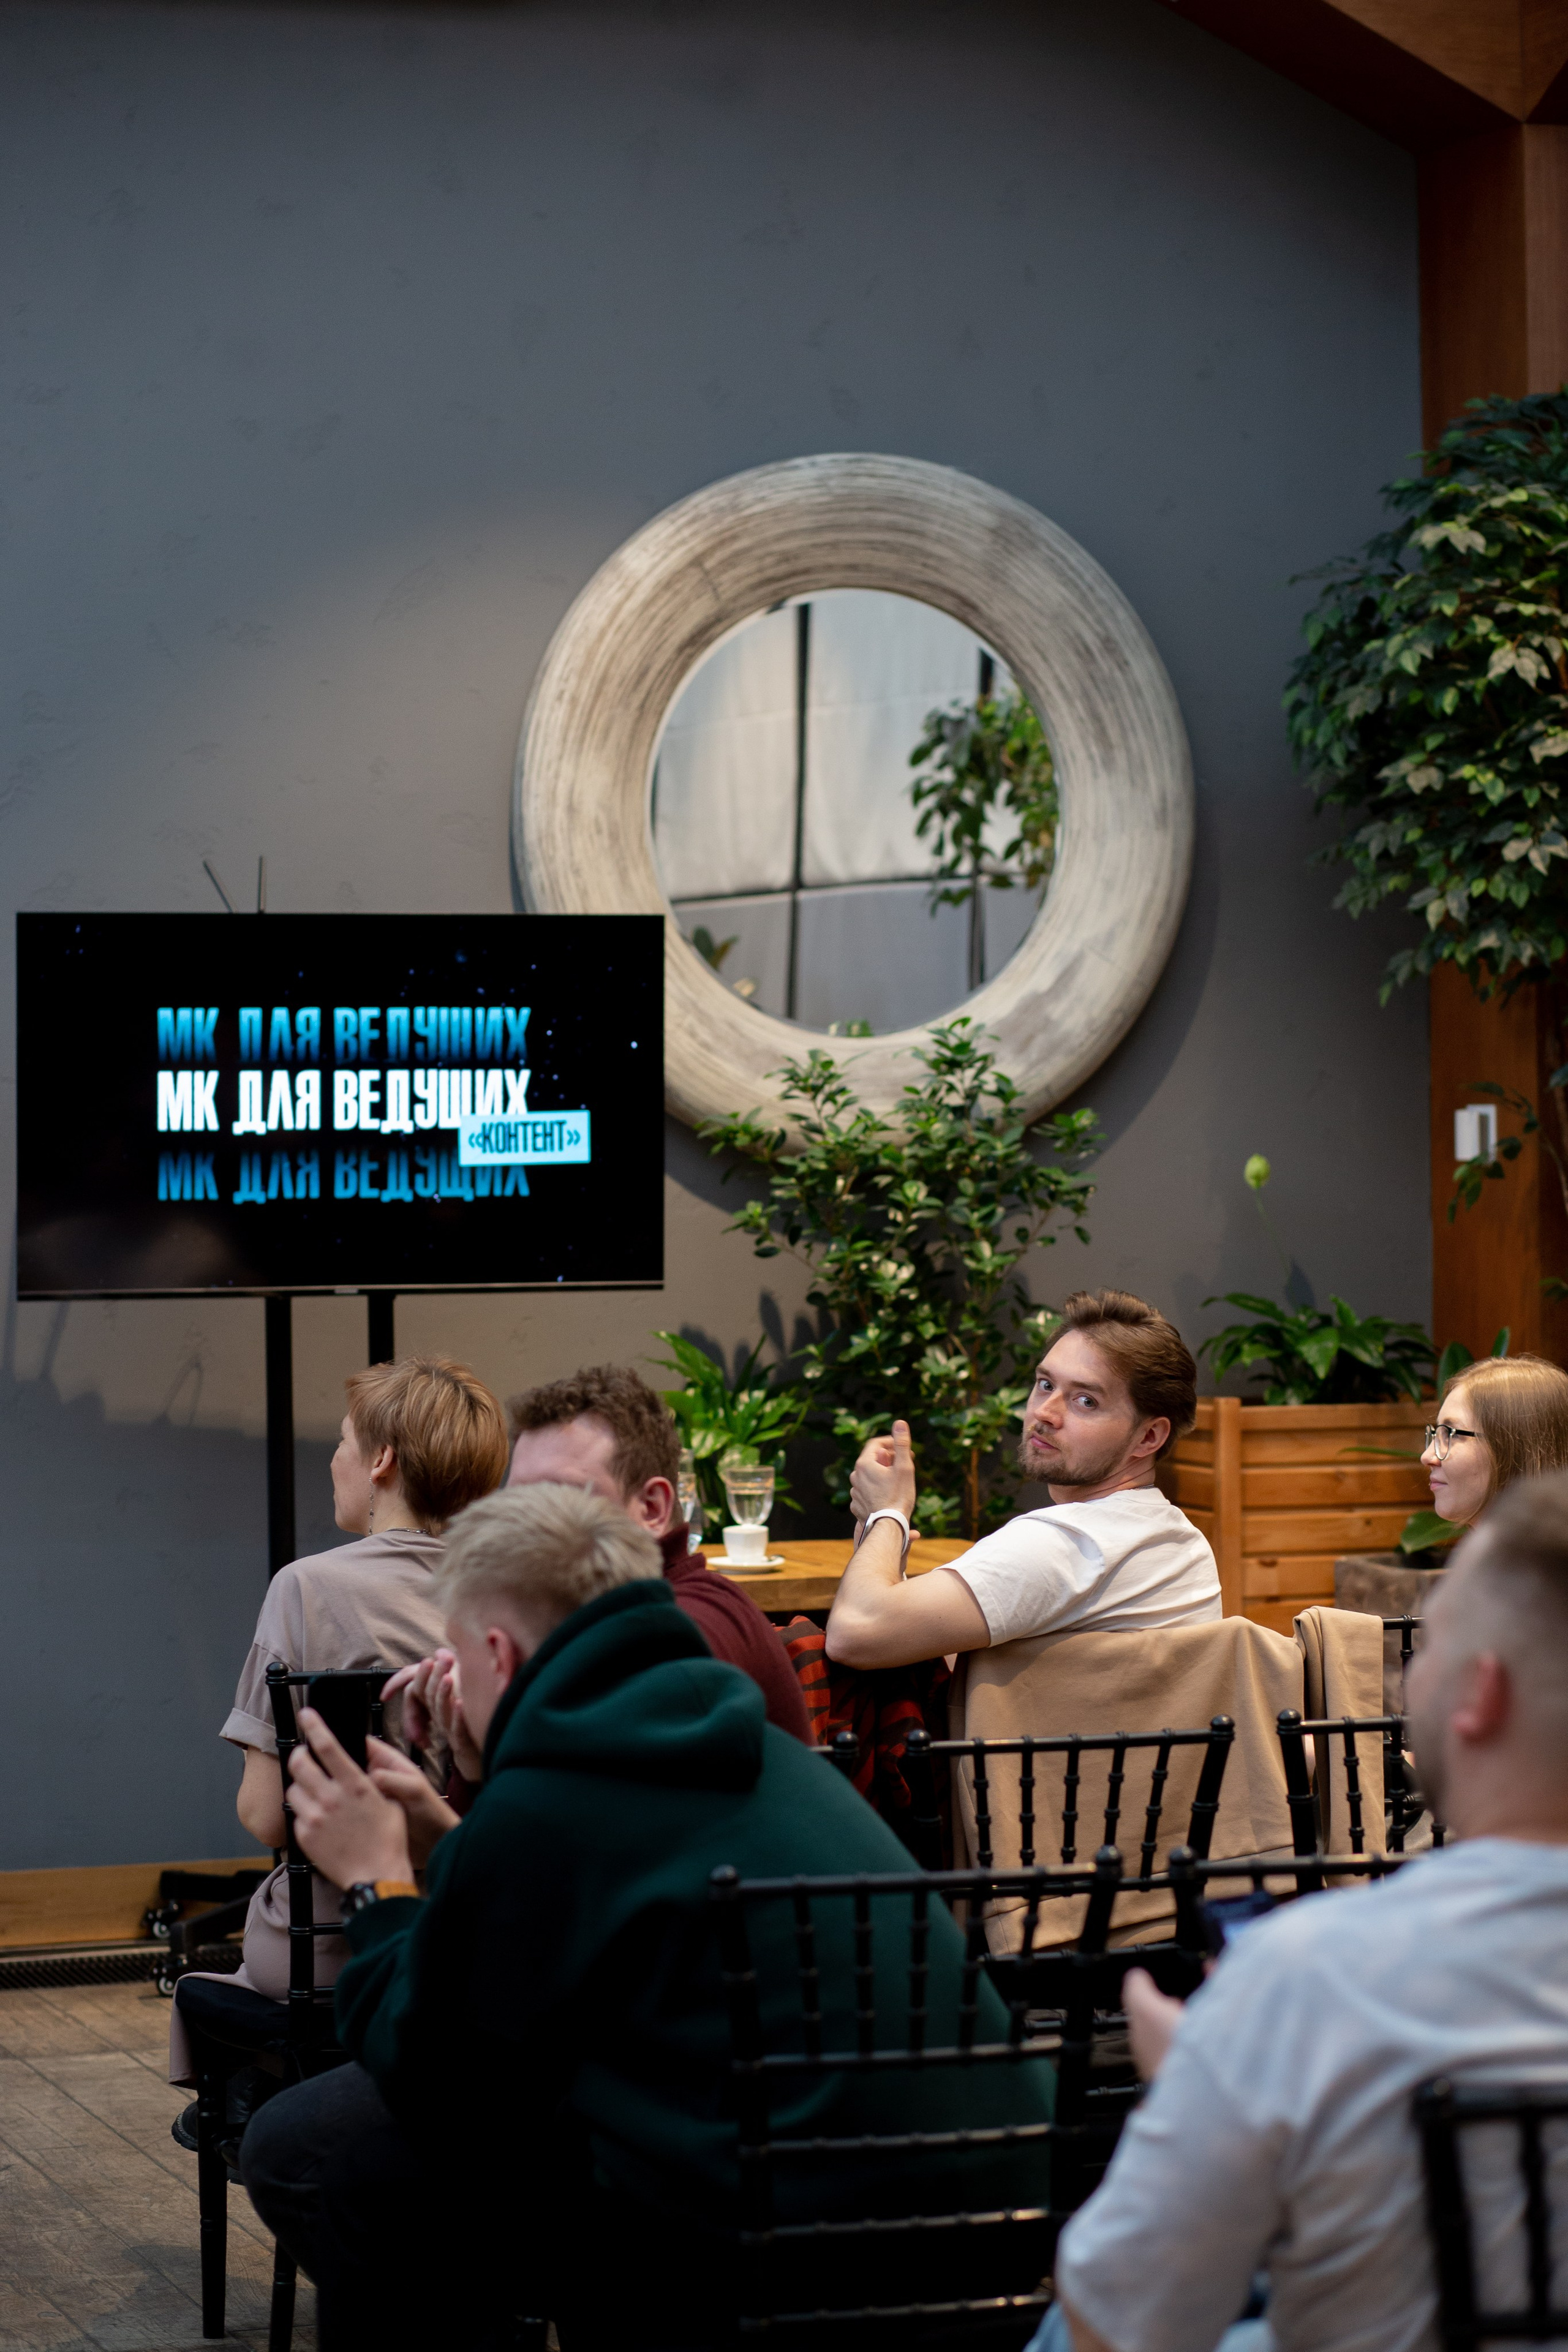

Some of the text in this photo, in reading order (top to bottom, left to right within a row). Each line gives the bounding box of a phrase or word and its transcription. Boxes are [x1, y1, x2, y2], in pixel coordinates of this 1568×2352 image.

[157, 1007, 219, 1063] МК
[157, 1069, 532, 1136] МК ДЛЯ ВЕДУЩИХ
[468, 1119, 581, 1155] «КОНТЕНТ»
[157, 1148, 219, 1201] МК
[232, 1148, 320, 1204] ДЛЯ
